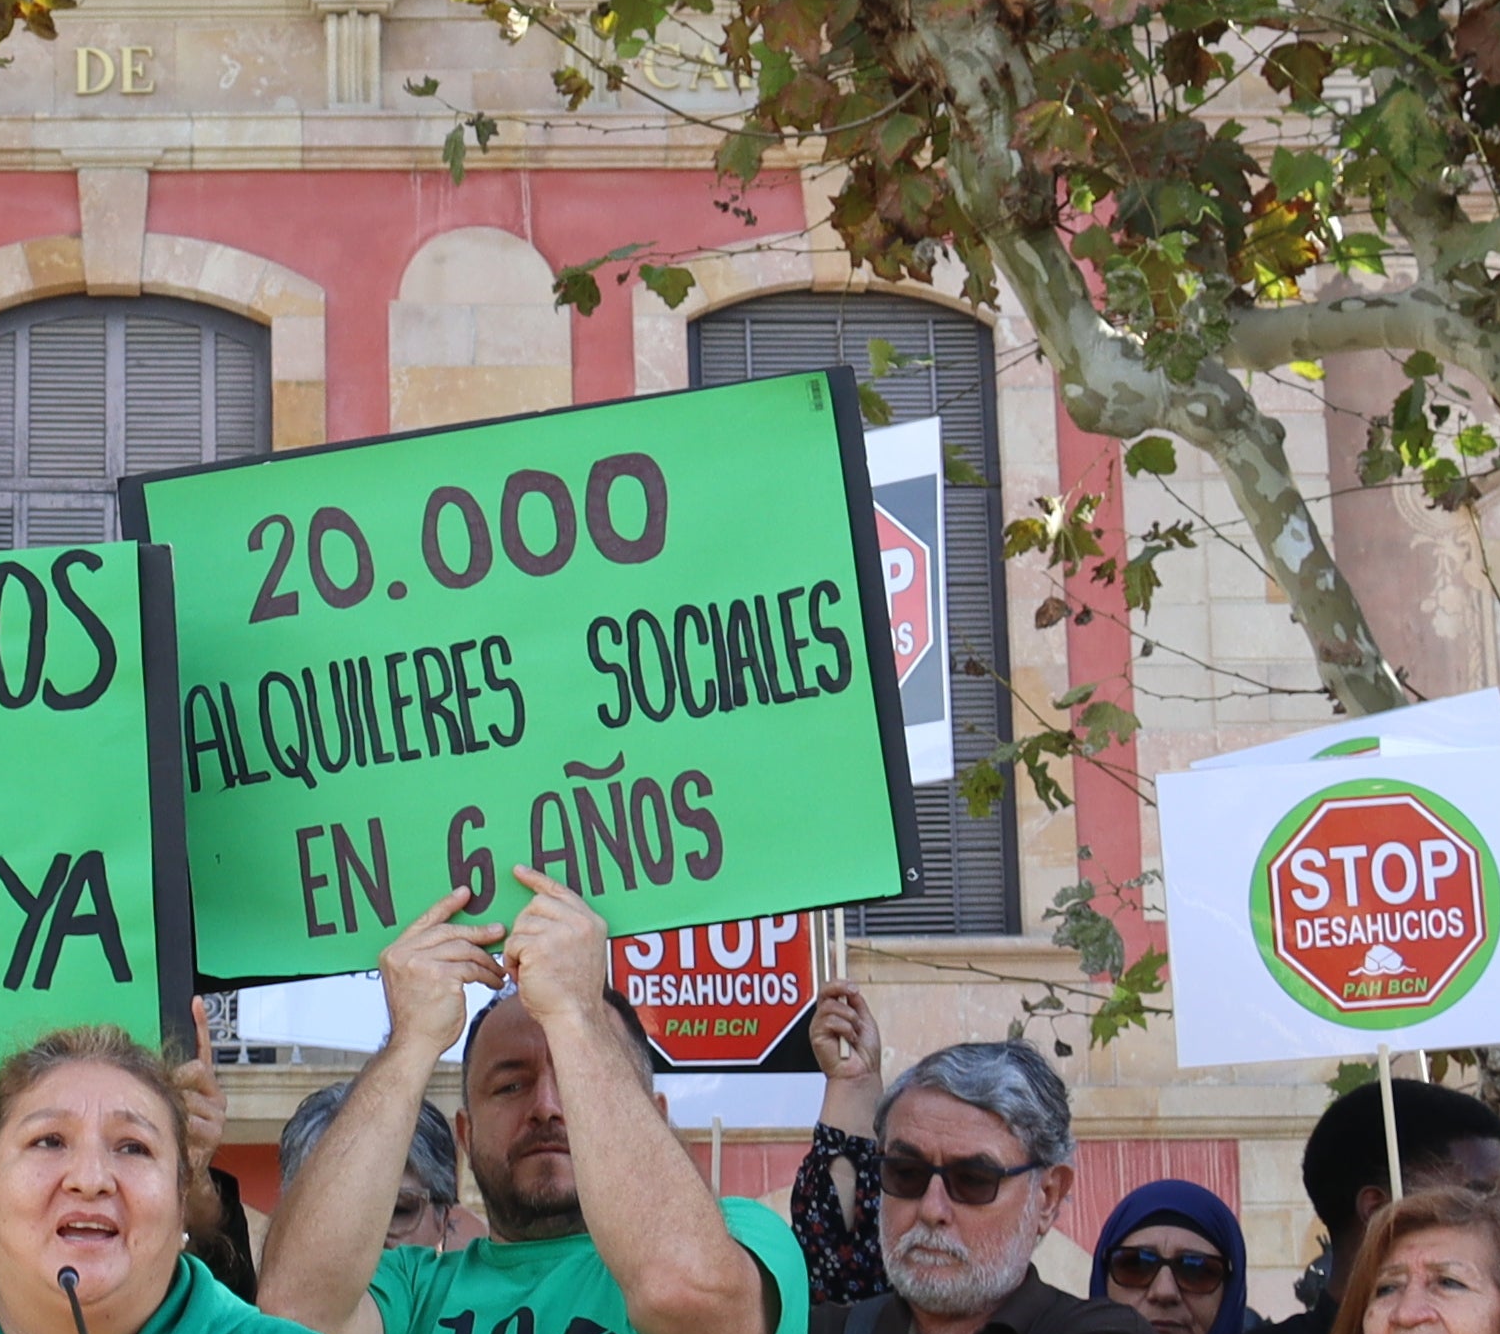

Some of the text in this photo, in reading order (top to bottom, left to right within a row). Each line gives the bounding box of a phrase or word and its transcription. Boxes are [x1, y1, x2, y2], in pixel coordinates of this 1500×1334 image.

[76, 46, 154, 95] DE
[248, 452, 668, 625] 20.000
[183, 635, 526, 794] ALQUILERES
[587, 579, 852, 729] SOCIALES
[295, 751, 724, 939] EN 6 AÑOS
[1290, 838, 1459, 911] STOP
[1295, 907, 1465, 949] DESAHUCIOS
[627, 971, 799, 1008] DESAHUCIOS
[1342, 976, 1428, 998] PAH BCN
[665, 1018, 758, 1036] PAH BCN
